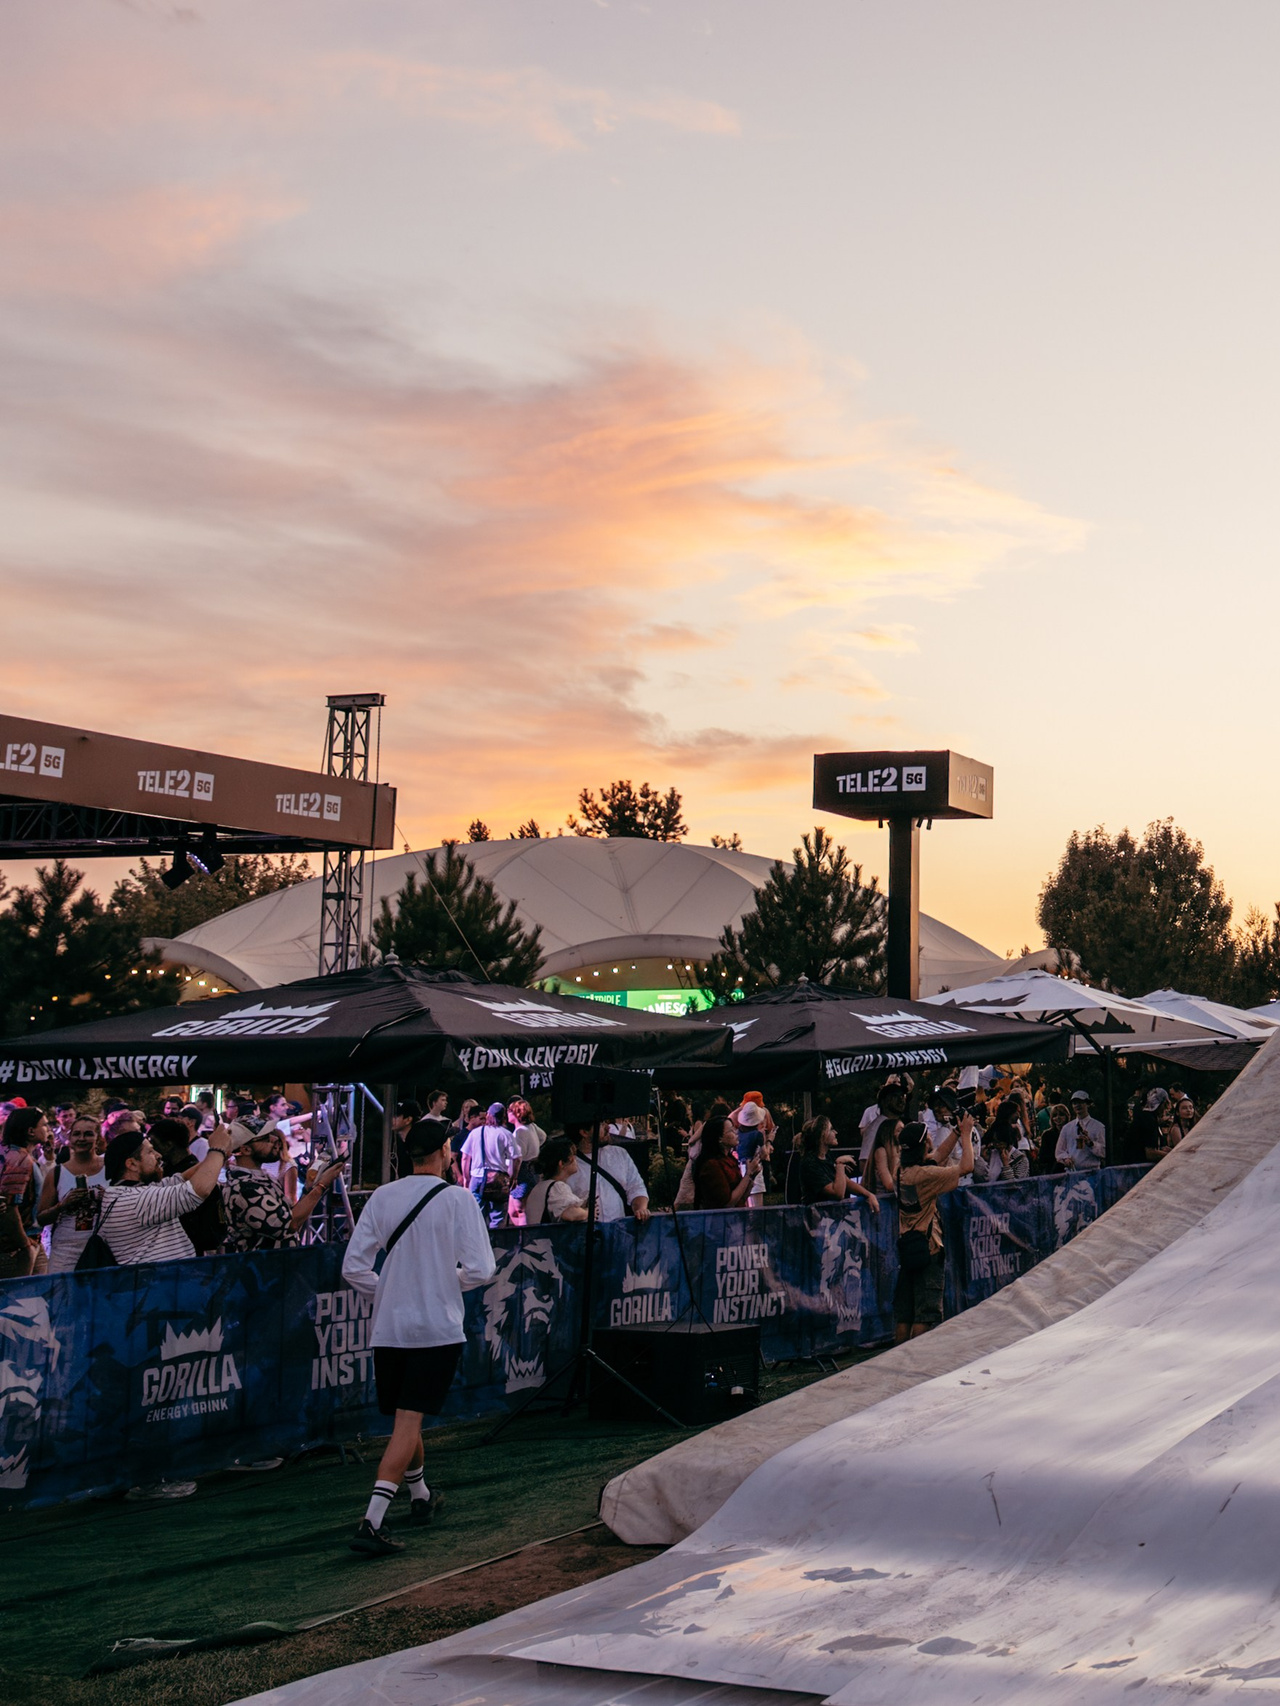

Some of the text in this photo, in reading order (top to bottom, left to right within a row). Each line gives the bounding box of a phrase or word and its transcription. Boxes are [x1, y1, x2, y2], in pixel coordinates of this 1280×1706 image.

[137, 769, 191, 798] TELE2
[836, 766, 923, 793] TELE2 5G
[275, 792, 322, 818] TELE2
[152, 1016, 330, 1037] GORILLA
[865, 1020, 979, 1039] GORILLA
[0, 1055, 198, 1083] #GORILLAENERGY
[825, 1048, 948, 1079] #GORILLAENERGY
[970, 1212, 1011, 1239] POWER
[716, 1243, 769, 1273] POWER
[969, 1234, 1002, 1259] YOUR
[970, 1252, 1021, 1281] INSTINCT
[715, 1269, 759, 1299] YOUR
[315, 1288, 373, 1325] POW
[610, 1291, 673, 1327] GORILLA
[713, 1290, 786, 1324] INSTINCT
[141, 1353, 243, 1407] GORILLA
[311, 1349, 375, 1391] INST
[146, 1397, 229, 1423] ENERGY DRINK
